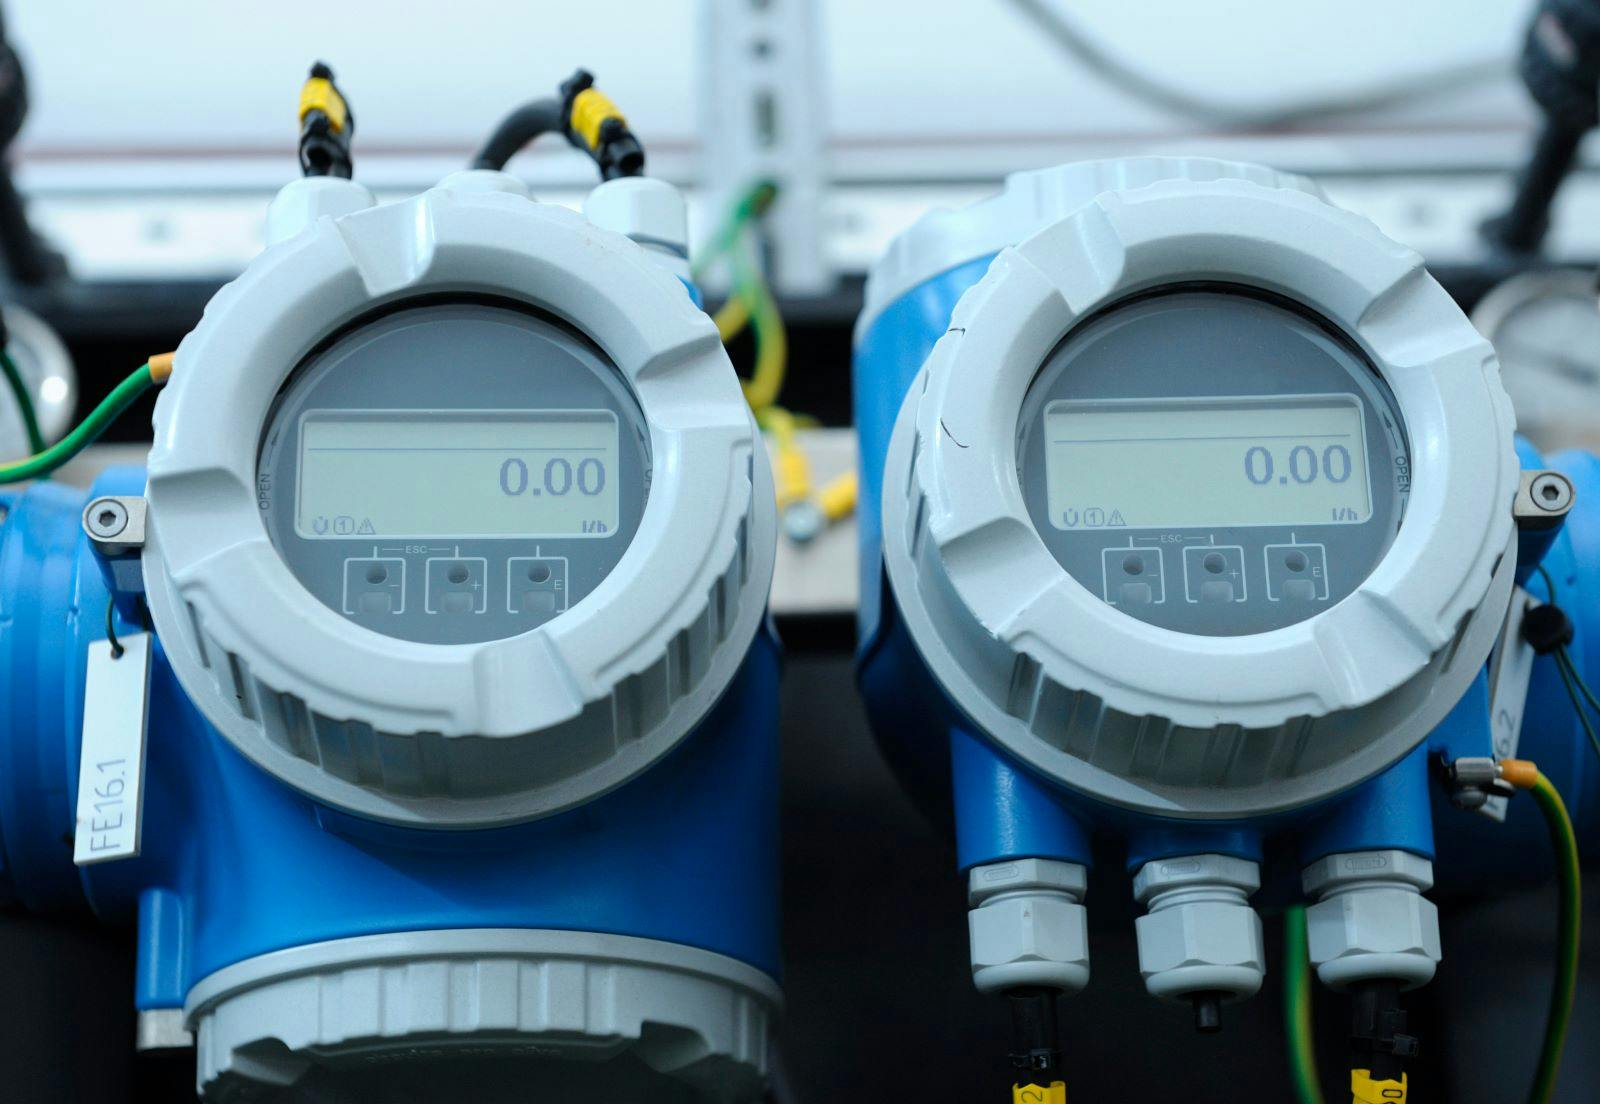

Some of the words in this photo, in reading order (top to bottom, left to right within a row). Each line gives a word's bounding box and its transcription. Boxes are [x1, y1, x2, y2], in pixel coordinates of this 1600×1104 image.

[500, 457, 606, 497] 0.00
[1244, 444, 1352, 485] 0.00
[1395, 456, 1410, 493] OPEN
[260, 473, 272, 510] OPEN
[405, 545, 428, 554] ESC
[1160, 534, 1183, 543] ESC
[553, 578, 563, 591] E
[1312, 566, 1321, 577] E
[90, 757, 126, 854] FE16.1
